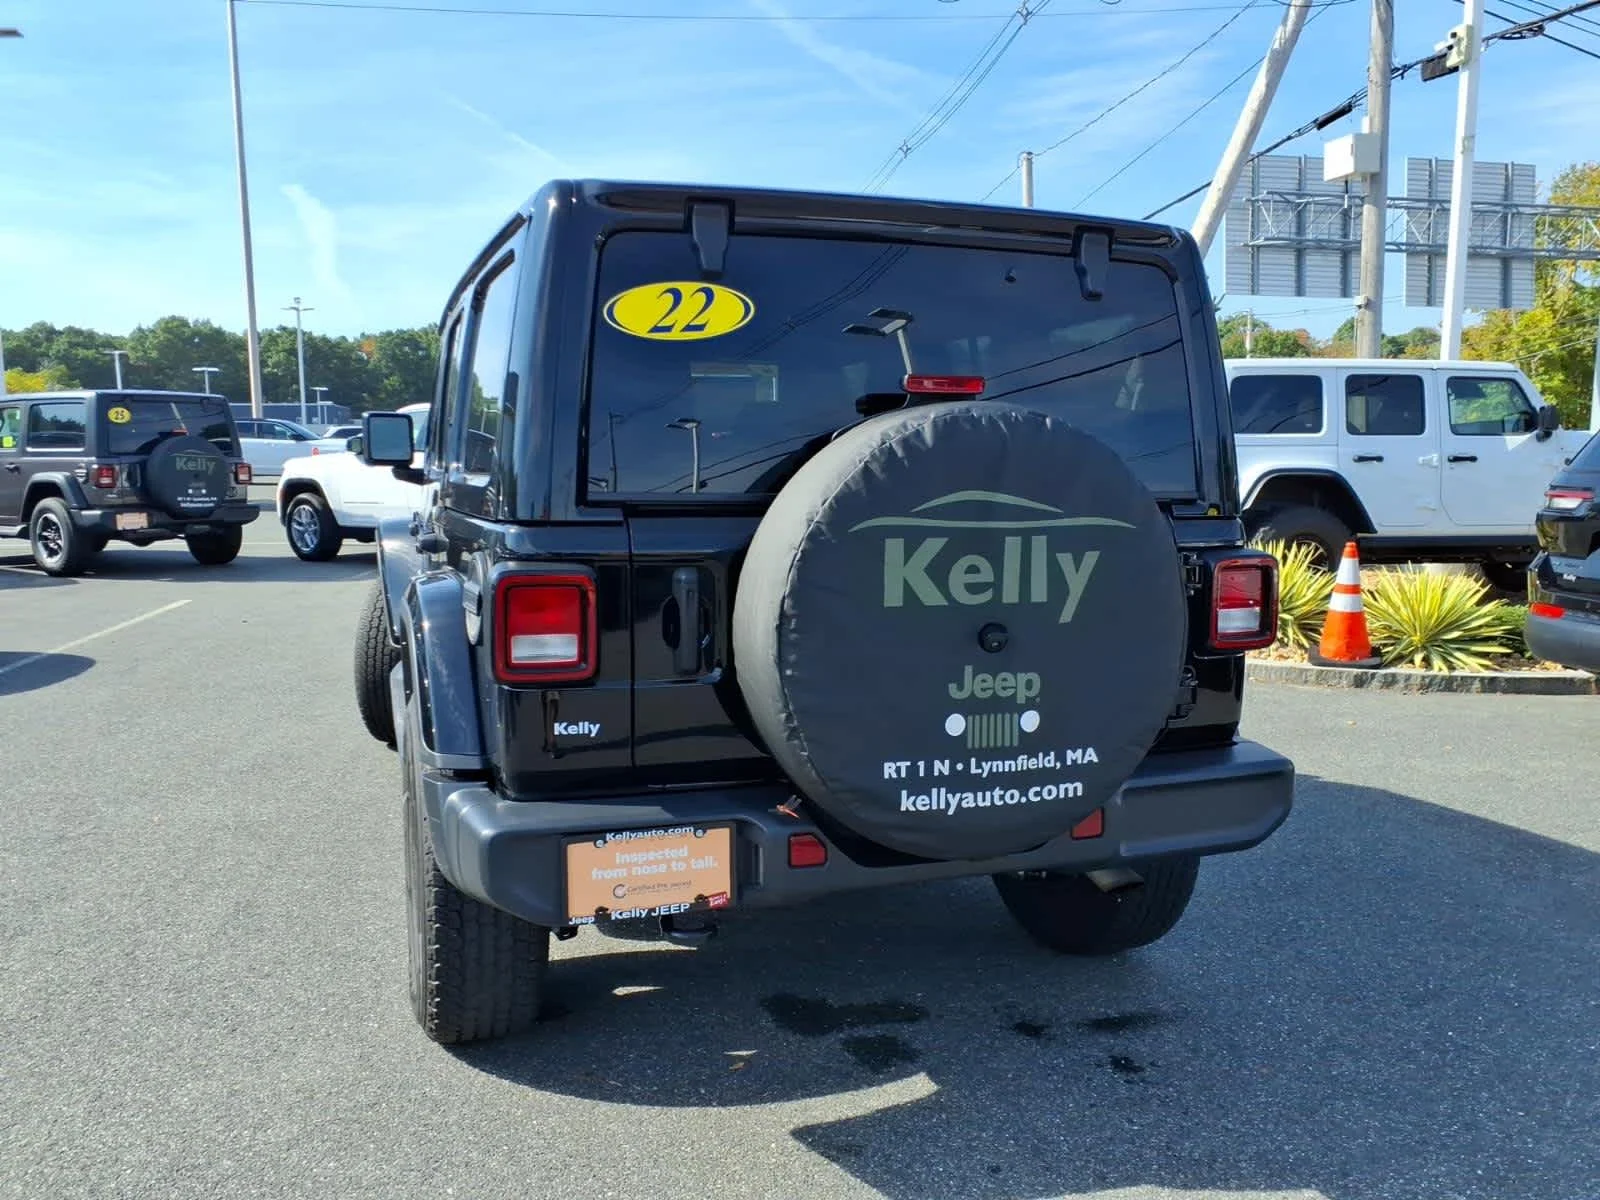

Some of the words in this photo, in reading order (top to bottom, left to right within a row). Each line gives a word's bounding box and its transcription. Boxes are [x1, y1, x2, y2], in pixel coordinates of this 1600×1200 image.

[647, 286, 715, 333] 22
[176, 457, 217, 476] Kelly
[883, 535, 1101, 624] Kelly
[948, 665, 1041, 704] Jeep
[553, 720, 600, 737] Kelly
[883, 761, 911, 779] RT
[917, 761, 925, 777] 1
[933, 759, 950, 776] N
[970, 751, 1061, 778] Lynnfield,
[1066, 747, 1099, 766] MA
[900, 781, 1083, 815] kellyauto.com
[605, 826, 694, 841] Kellyauto.com
[671, 860, 688, 872] to
[568, 916, 595, 925] Jeep
[611, 907, 649, 921] Kelly
[651, 903, 691, 916] JEEP
